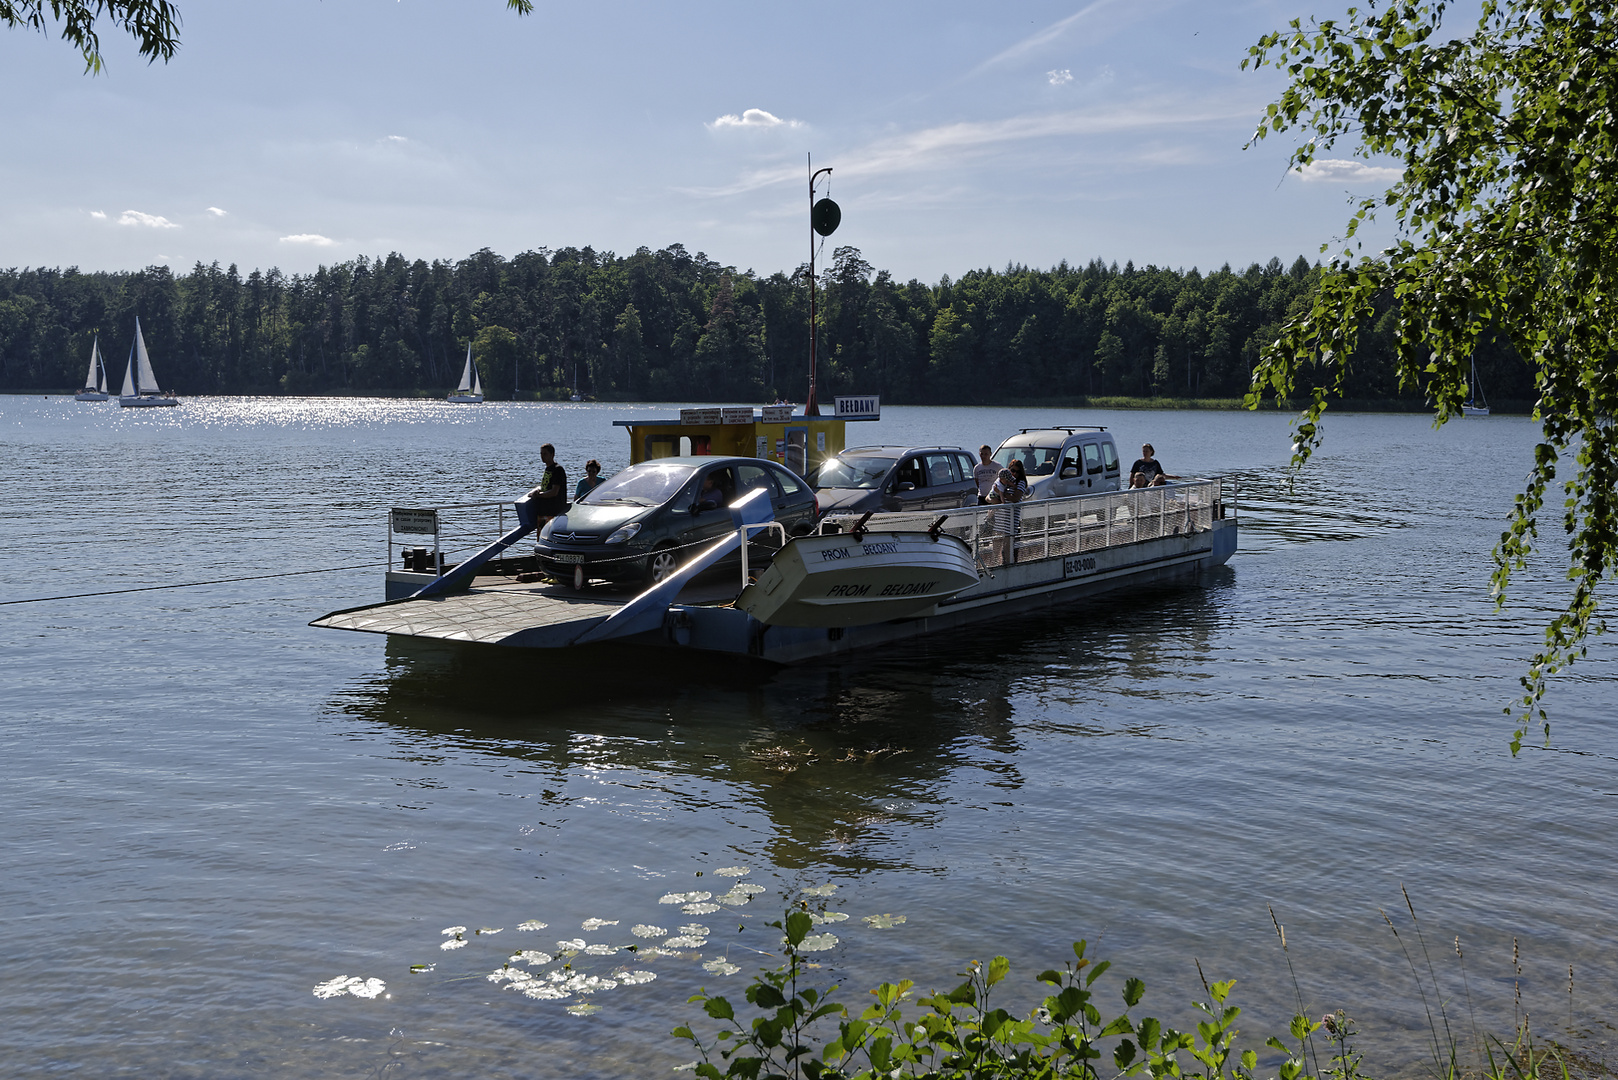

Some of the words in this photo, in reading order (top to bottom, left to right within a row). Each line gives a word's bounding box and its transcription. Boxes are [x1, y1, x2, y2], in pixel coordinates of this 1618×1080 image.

[840, 400, 874, 413] BEŁDANY
[821, 548, 850, 561] PROM
[827, 584, 871, 597] PROM
